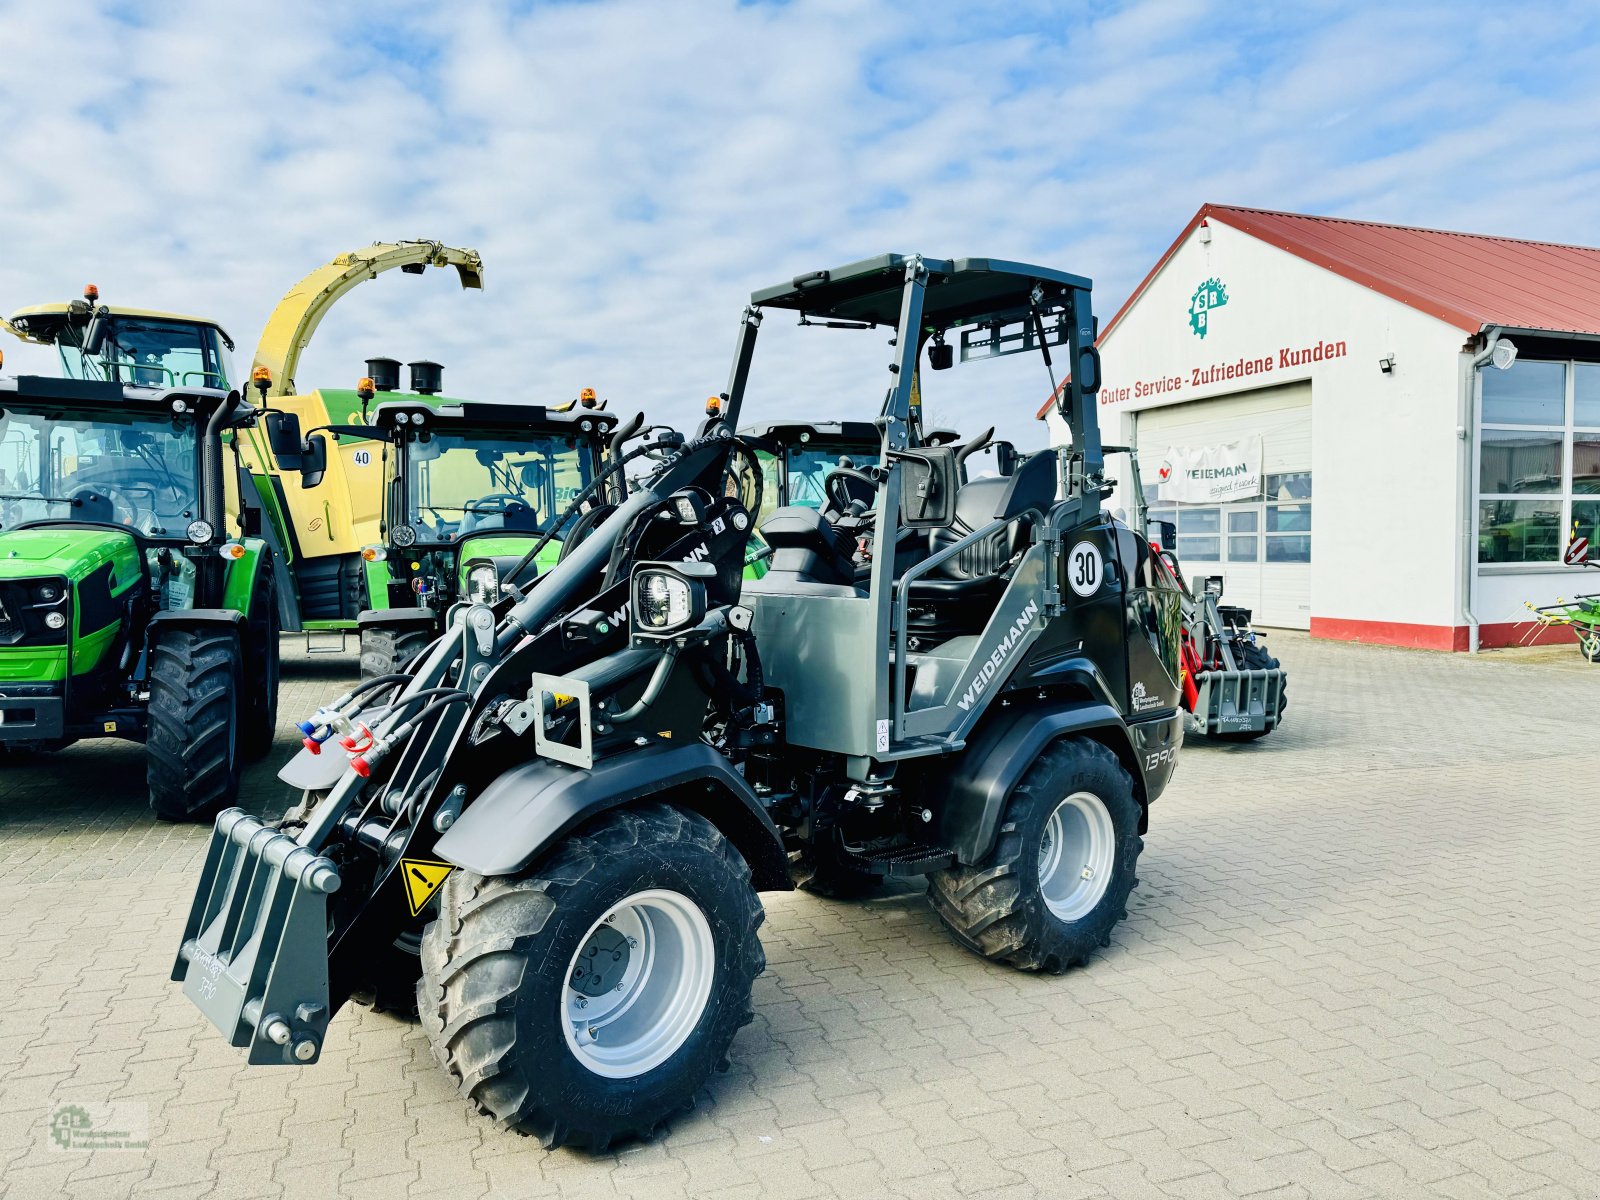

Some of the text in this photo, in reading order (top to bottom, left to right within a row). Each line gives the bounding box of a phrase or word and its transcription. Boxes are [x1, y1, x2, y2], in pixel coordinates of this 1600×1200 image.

[1101, 387, 1131, 405] Guter
[1134, 375, 1182, 398] Service
[1191, 358, 1273, 387] Zufriedene
[1279, 340, 1347, 369] Kunden
[355, 452, 369, 464] 40
[1075, 552, 1096, 587] 30
[957, 598, 1039, 712] WEIDEMANN
[1145, 746, 1177, 772] 1390
